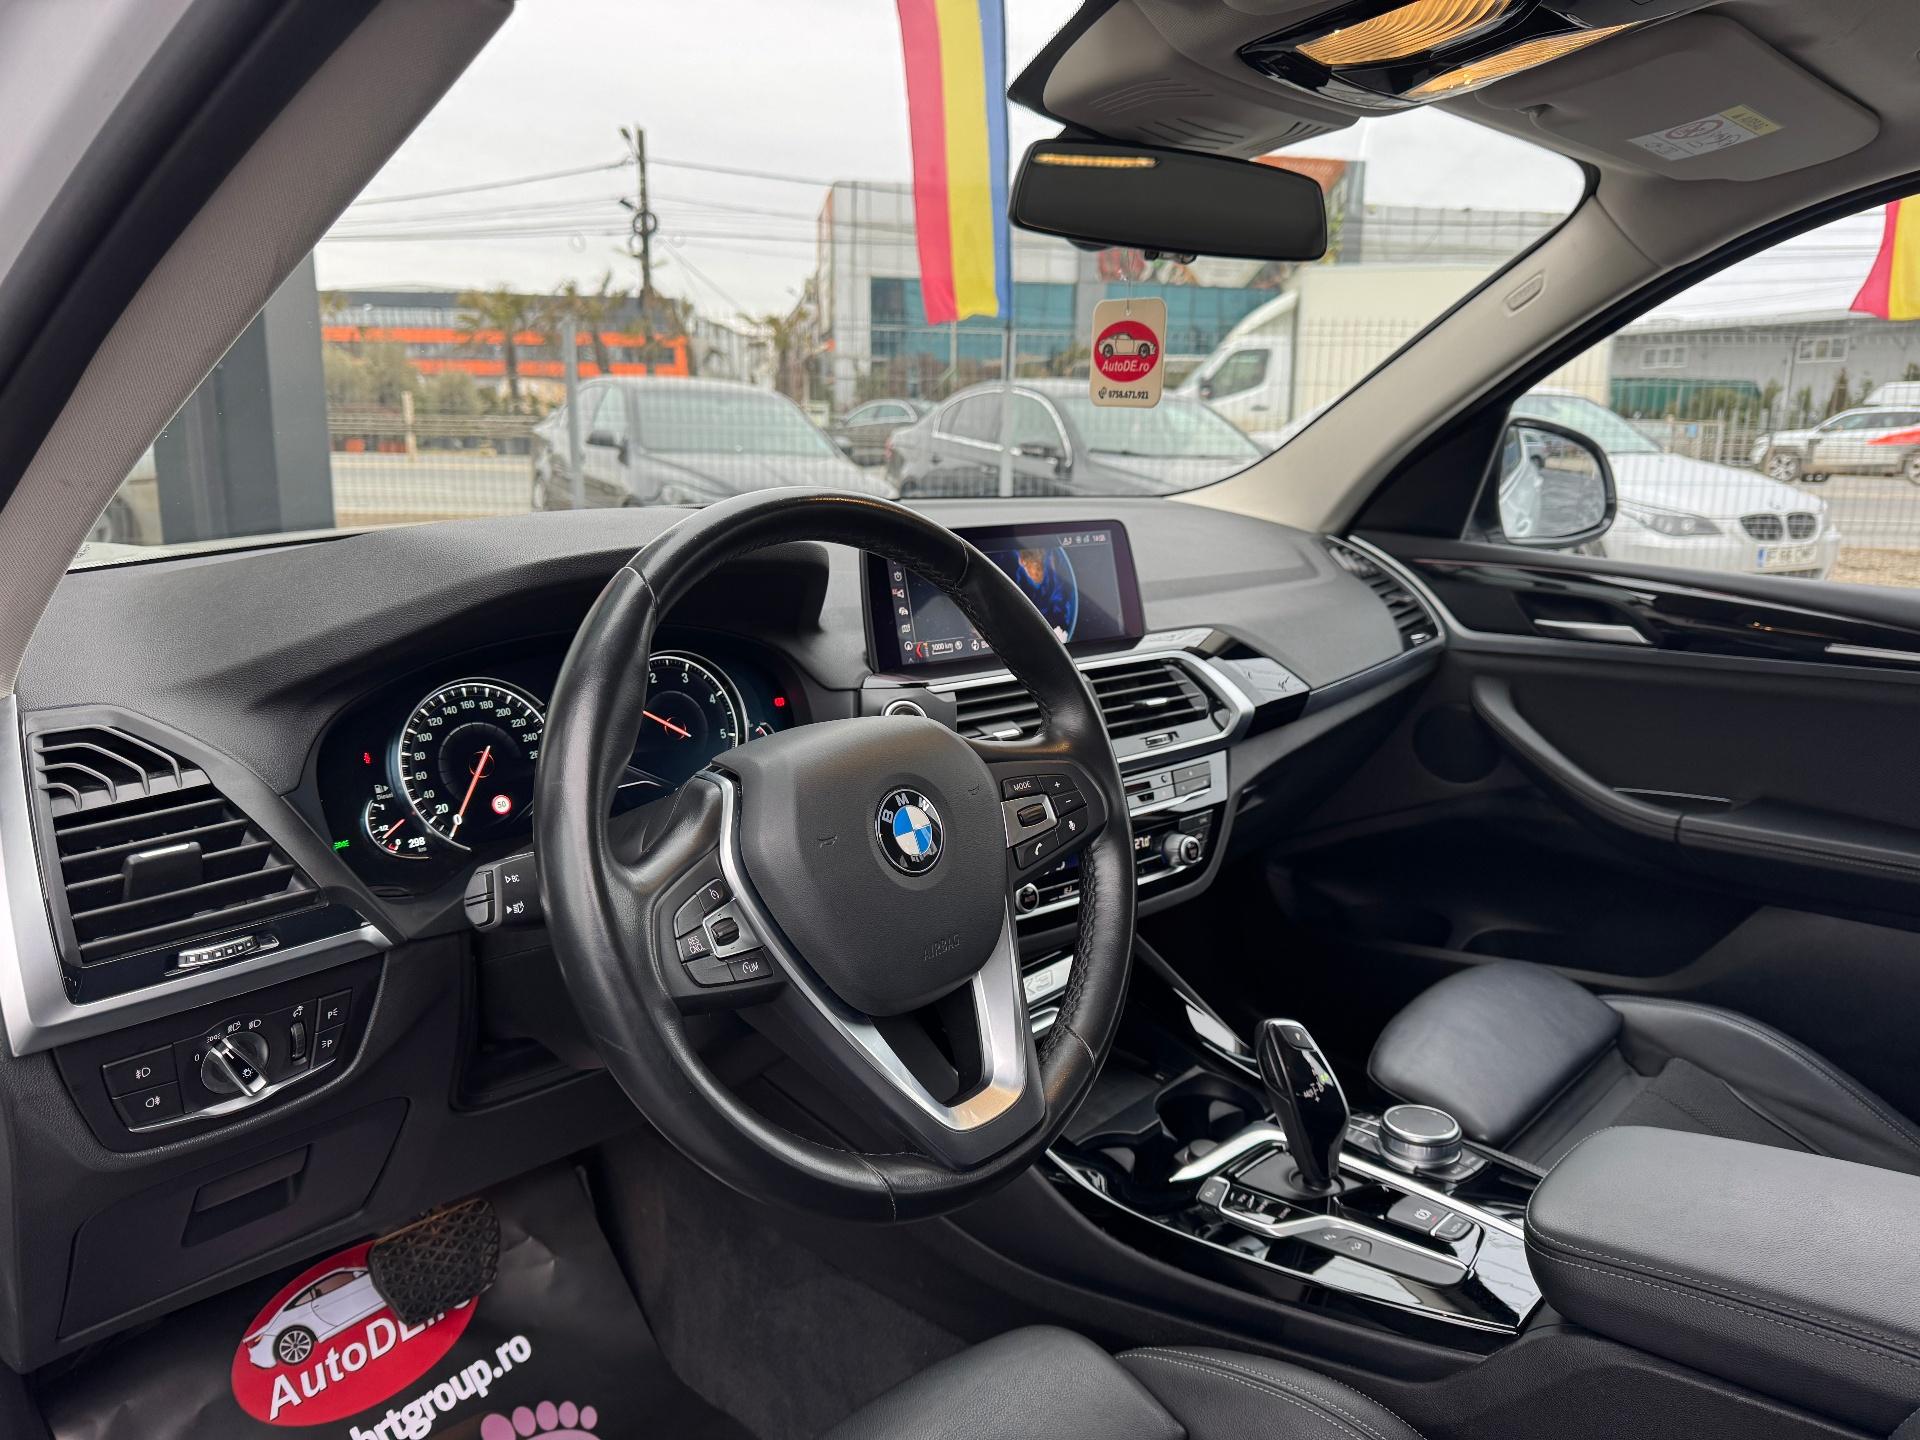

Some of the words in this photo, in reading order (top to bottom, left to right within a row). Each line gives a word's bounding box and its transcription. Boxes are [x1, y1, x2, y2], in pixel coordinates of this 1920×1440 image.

[1102, 360, 1150, 372] AutoDE.ro
[650, 672, 657, 683] 2
[681, 672, 689, 683] 3
[709, 693, 716, 704] 4
[460, 700, 475, 709] 160
[479, 700, 494, 709] 180
[442, 706, 458, 715] 140
[495, 707, 512, 717] 200
[427, 716, 443, 726] 120
[511, 717, 527, 728] 220
[417, 732, 433, 742] 100
[522, 733, 538, 743] 240
[720, 728, 727, 739] 5
[414, 751, 426, 760] 80
[416, 771, 428, 781] 60
[1013, 780, 1032, 791] MODE
[423, 789, 435, 799] 40
[435, 803, 449, 814] 20
[453, 814, 462, 825] 0
[408, 836, 426, 848] 298
